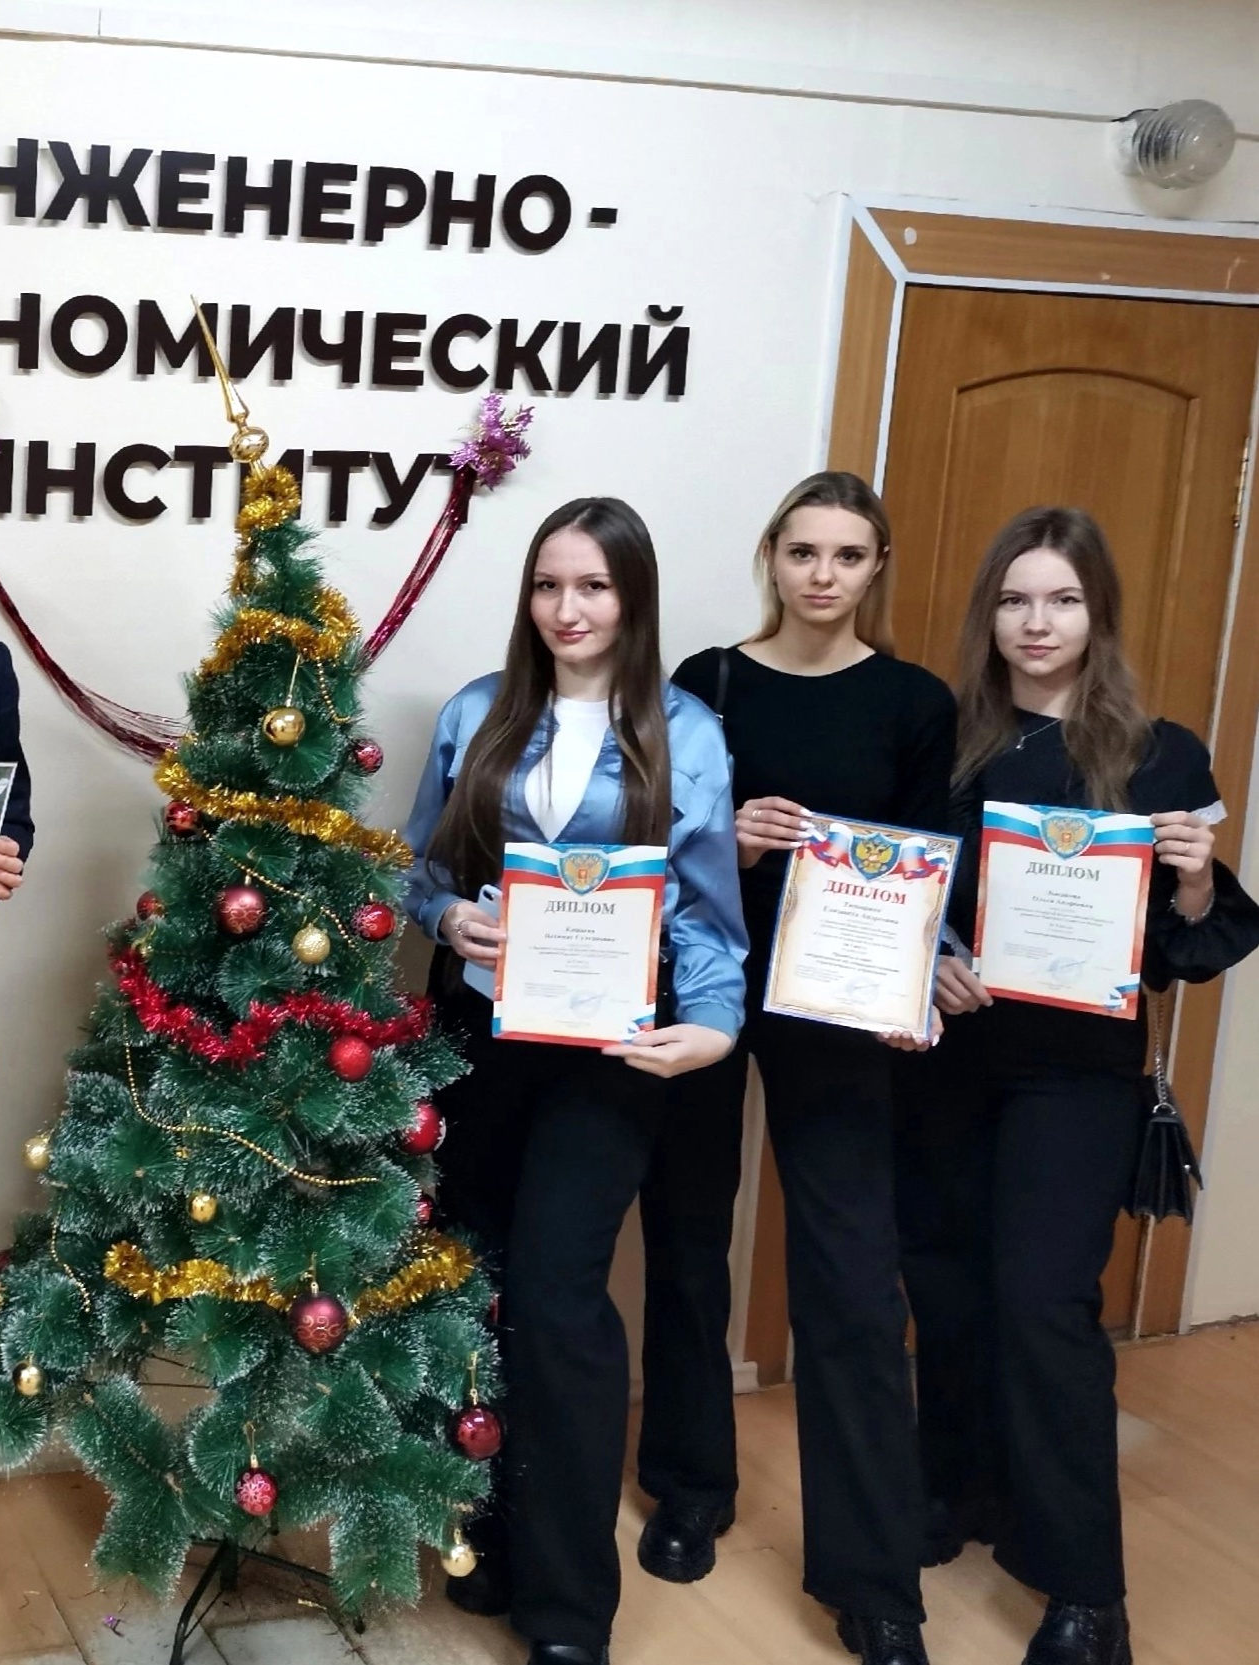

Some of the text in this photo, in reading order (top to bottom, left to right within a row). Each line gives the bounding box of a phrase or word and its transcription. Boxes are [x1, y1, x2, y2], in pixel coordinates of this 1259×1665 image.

[1025, 861, 1101, 881] ДИПЛОМ
[822, 879, 907, 905] ДИПЛОМ
[544, 900, 616, 915] ДИПЛОМ
